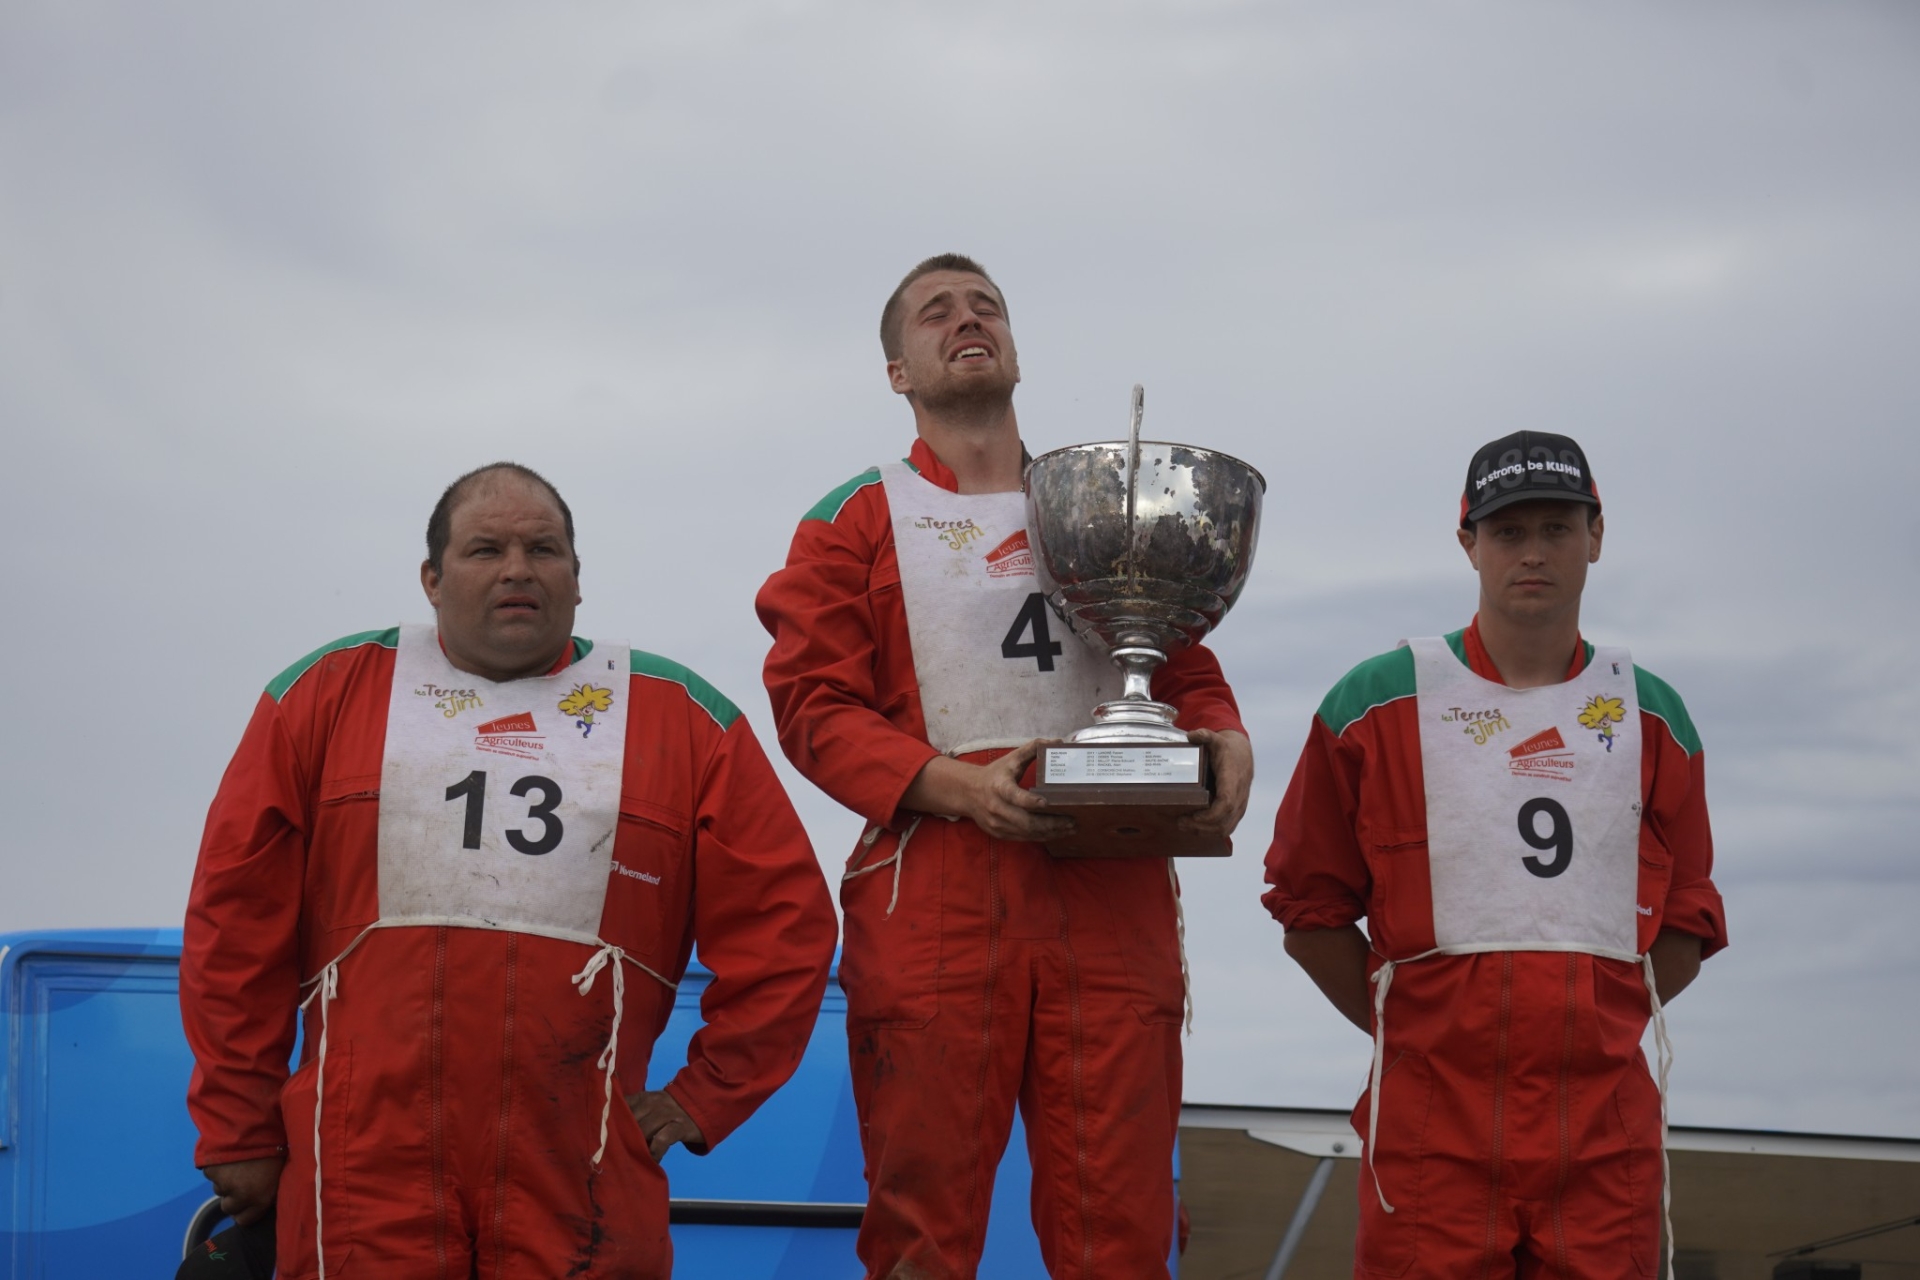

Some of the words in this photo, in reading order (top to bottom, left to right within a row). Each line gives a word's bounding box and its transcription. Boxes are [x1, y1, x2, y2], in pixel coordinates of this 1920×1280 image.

[1476, 476, 1488, 490] be
[1488, 463, 1526, 482] strong,
[1527, 460, 1544, 471] be
[1546, 461, 1581, 478] KUHN
[920, 516, 975, 530] Terres
[938, 533, 951, 541] de
[943, 524, 985, 551] Jim
[997, 538, 1029, 557] Jeune
[993, 555, 1031, 571] Agricult
[1001, 592, 1062, 672] 4
[422, 683, 476, 698] Terres
[435, 700, 447, 709] de
[442, 695, 484, 719] Jim
[1448, 707, 1502, 722] Terres
[1463, 726, 1477, 735] de
[1470, 716, 1511, 745] Jim
[482, 735, 544, 750] Agriculteurs
[1516, 758, 1575, 770] Agriculteurs
[445, 770, 564, 856] 13
[1517, 797, 1574, 879] 9
[618, 864, 662, 886] Kverneland
